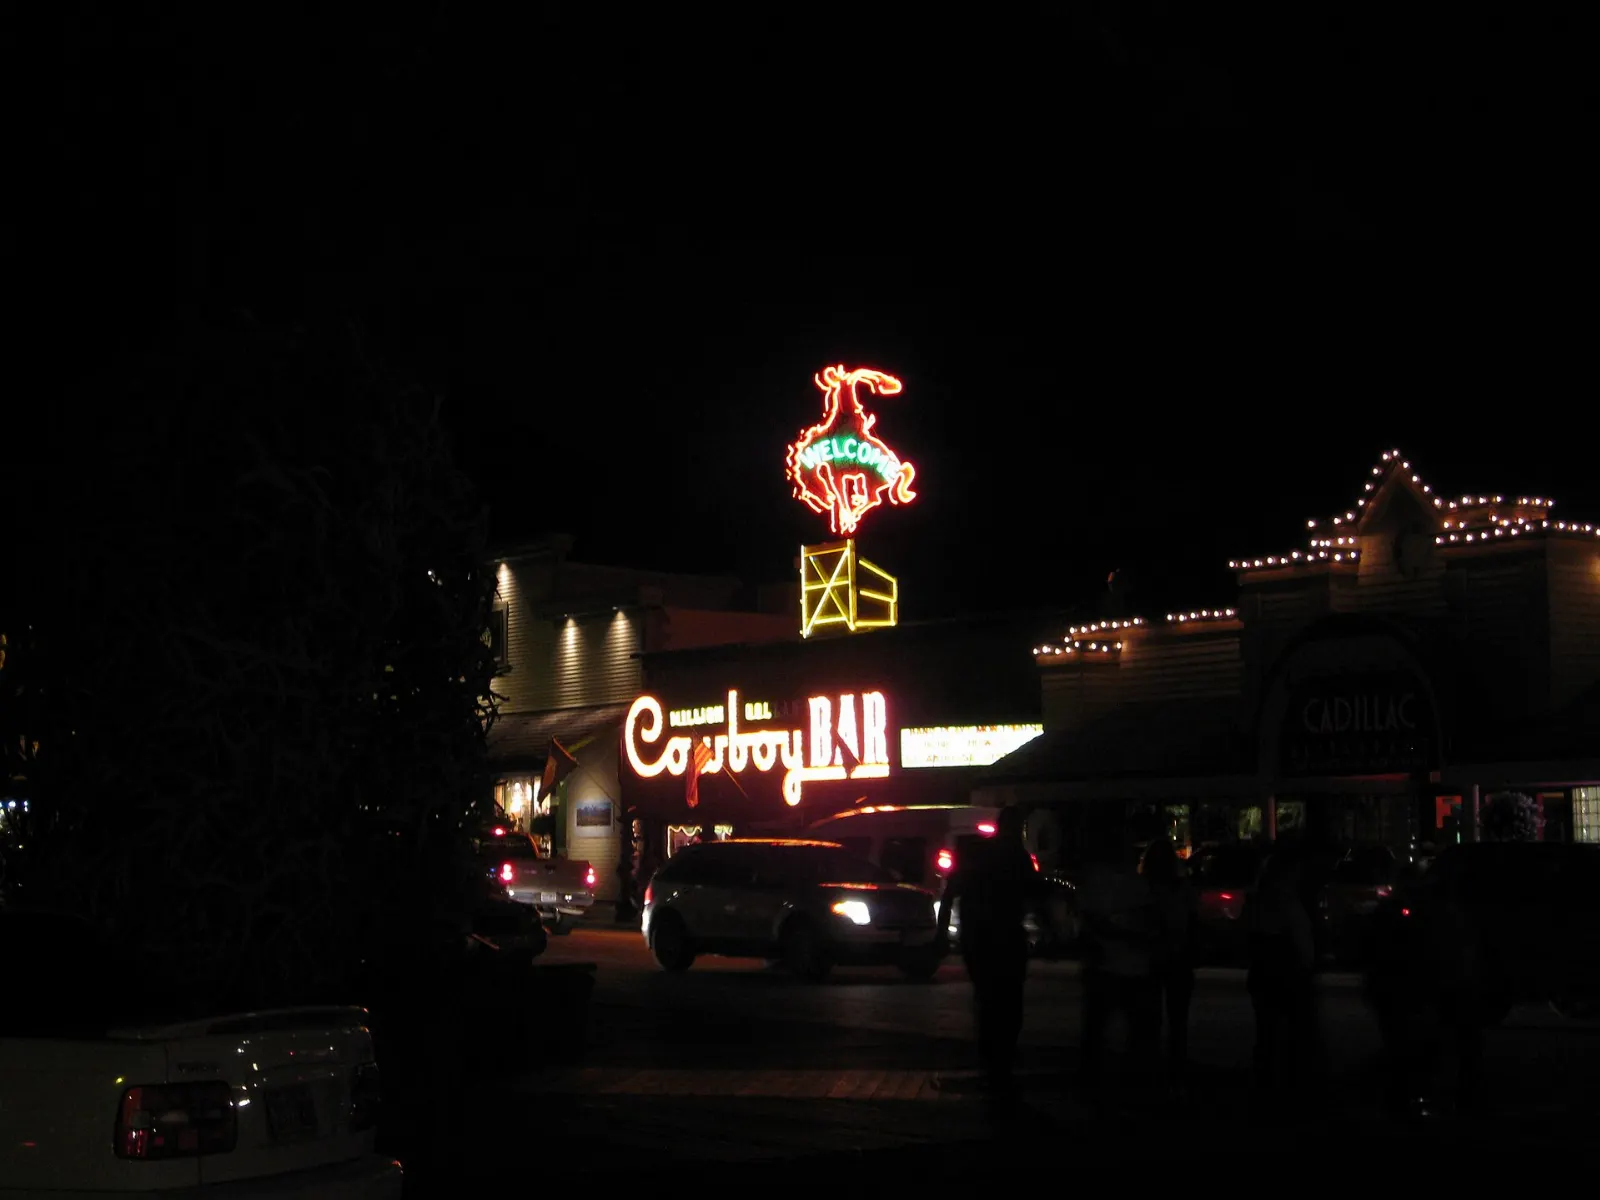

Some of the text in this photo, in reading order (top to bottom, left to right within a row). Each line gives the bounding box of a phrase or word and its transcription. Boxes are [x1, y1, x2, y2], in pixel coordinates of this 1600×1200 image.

[799, 437, 901, 484] WELCOME
[669, 705, 725, 727] MILLION
[807, 691, 890, 768] BAR
[1302, 691, 1417, 735] CADILLAC
